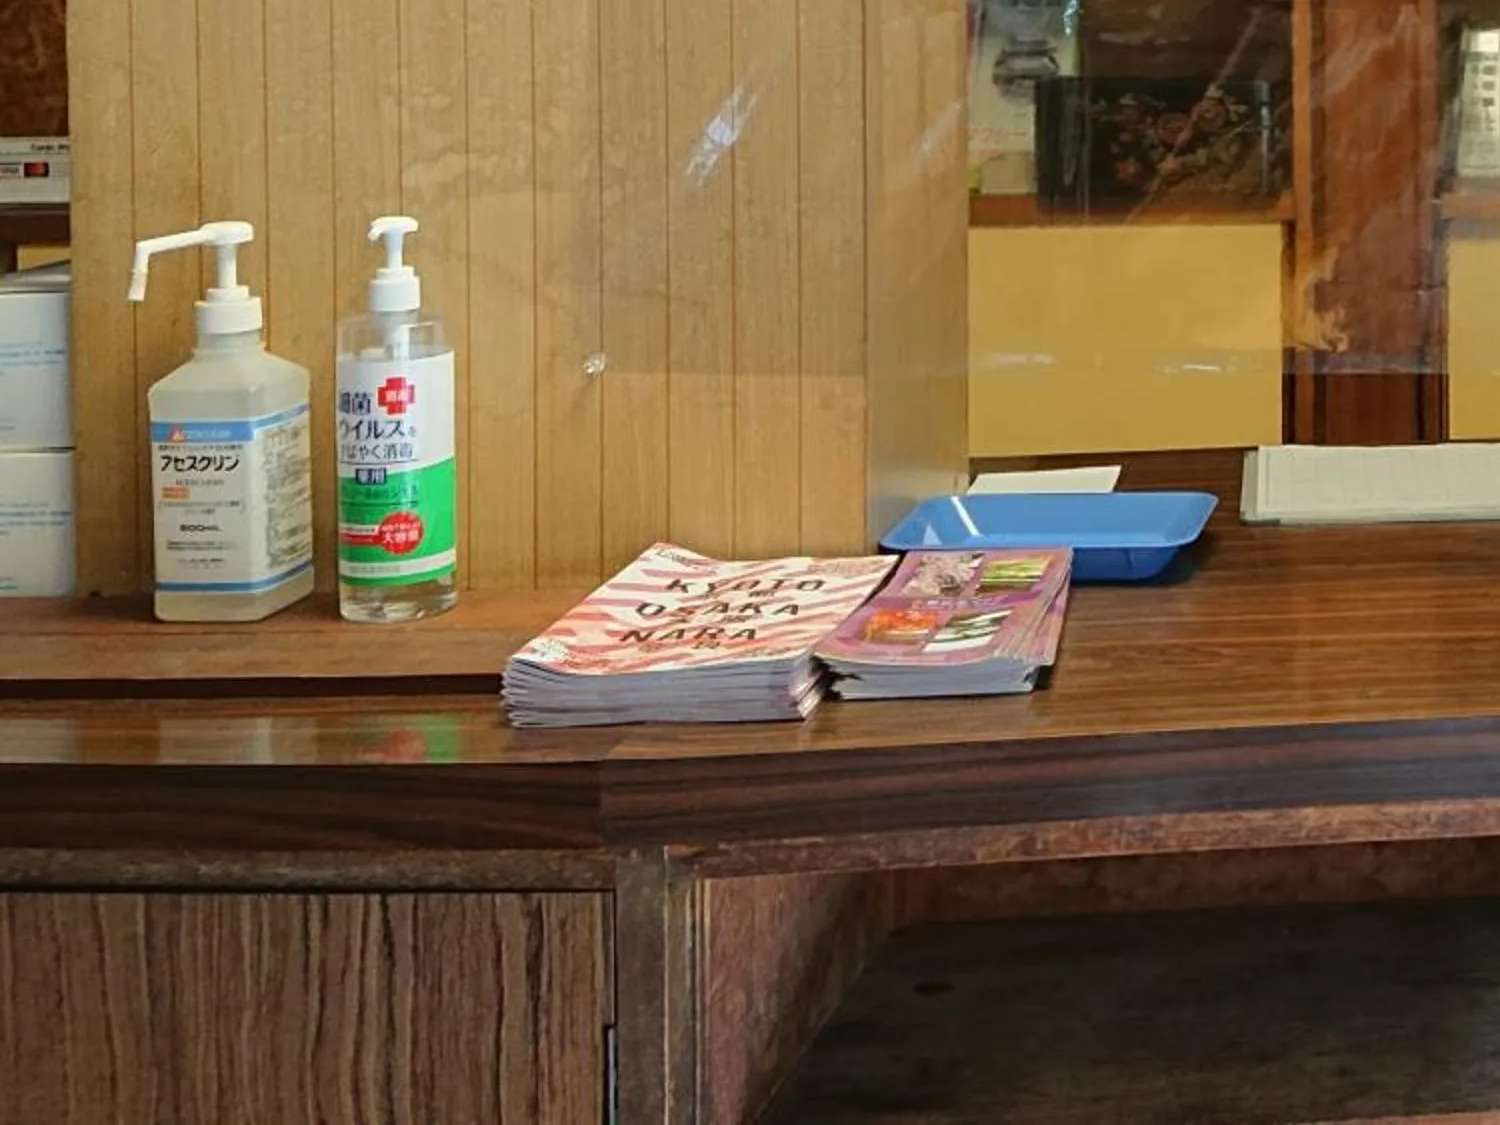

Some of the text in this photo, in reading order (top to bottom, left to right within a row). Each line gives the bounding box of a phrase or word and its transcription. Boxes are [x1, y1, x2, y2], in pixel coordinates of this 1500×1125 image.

[160, 454, 241, 472] アセスクリン
[666, 577, 828, 595] KYOTO
[635, 601, 803, 619] OSAKA
[619, 628, 759, 643] NARA
